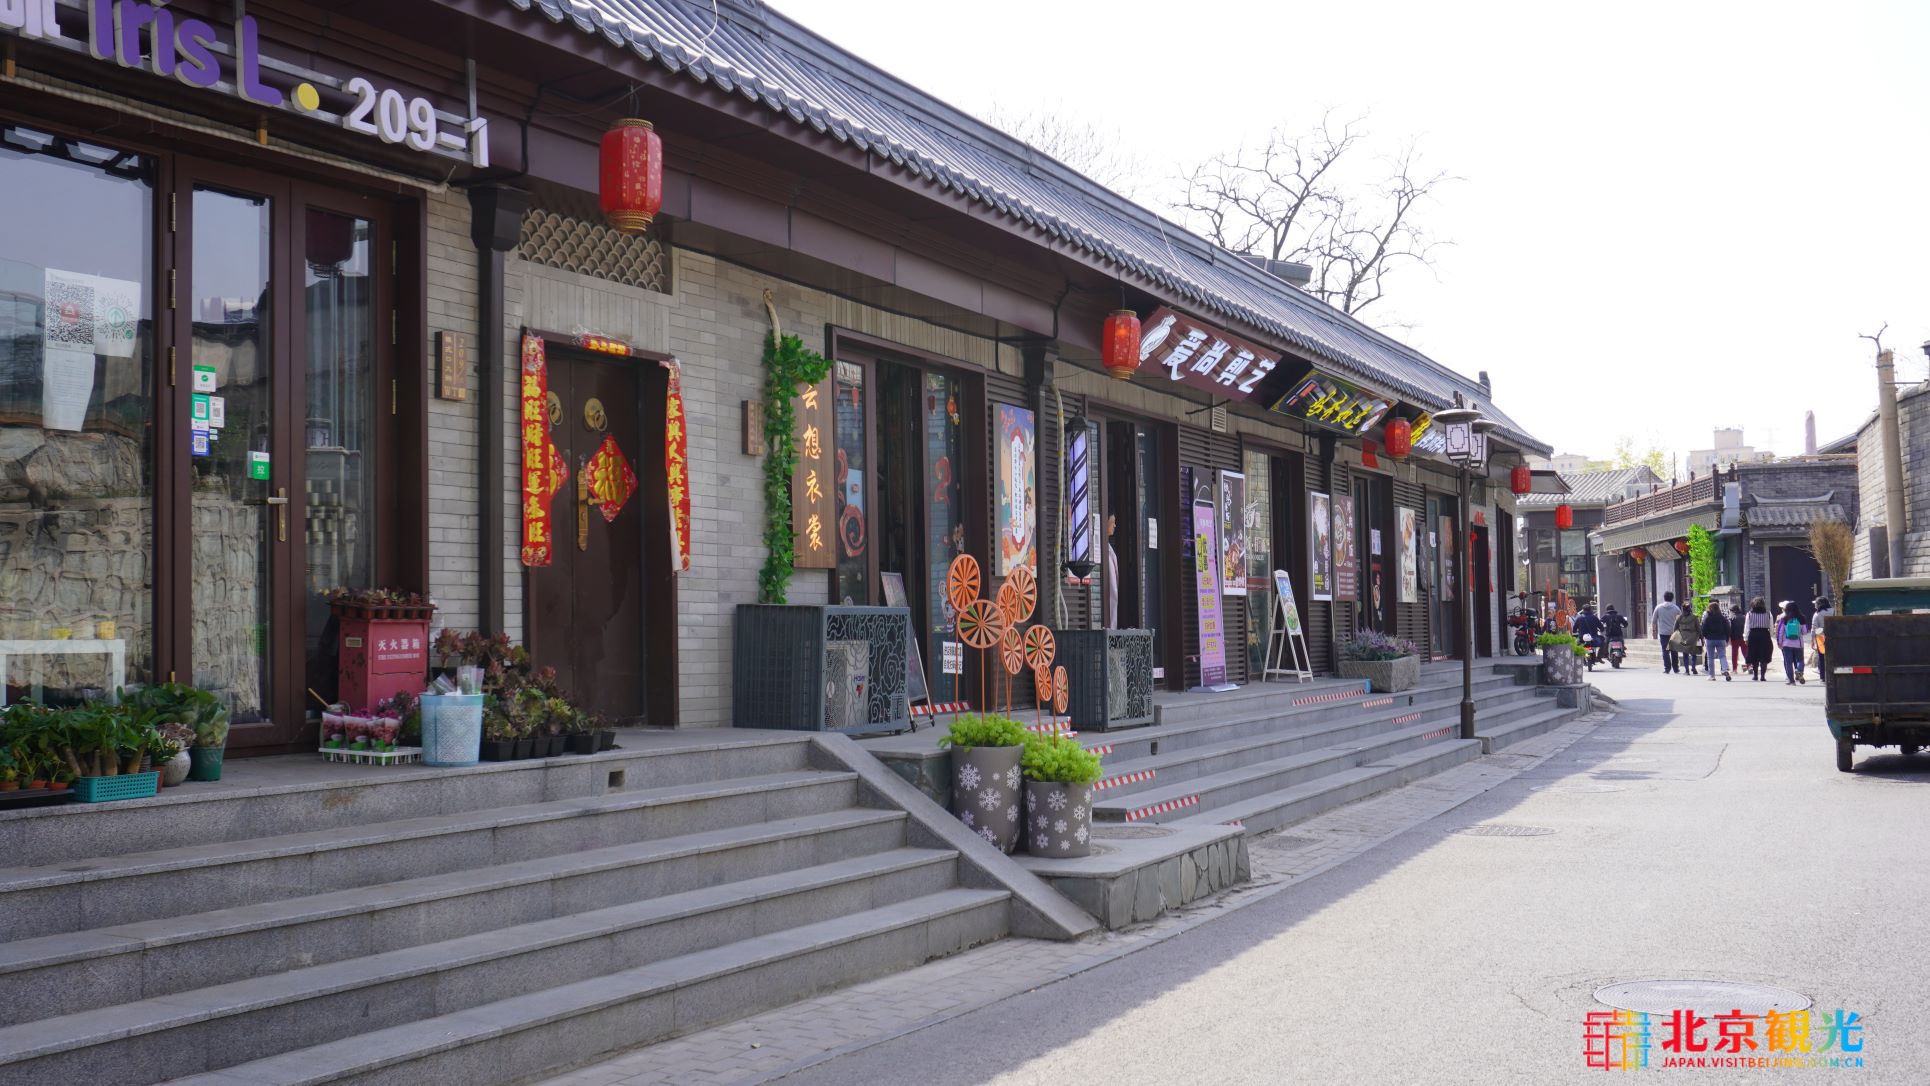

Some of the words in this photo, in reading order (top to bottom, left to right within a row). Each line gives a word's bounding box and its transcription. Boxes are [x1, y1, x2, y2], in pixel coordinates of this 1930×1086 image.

[343, 77, 489, 168] 209-1
[1161, 326, 1277, 394] 爱尚剪艺
[802, 385, 823, 551] 云想衣裳
